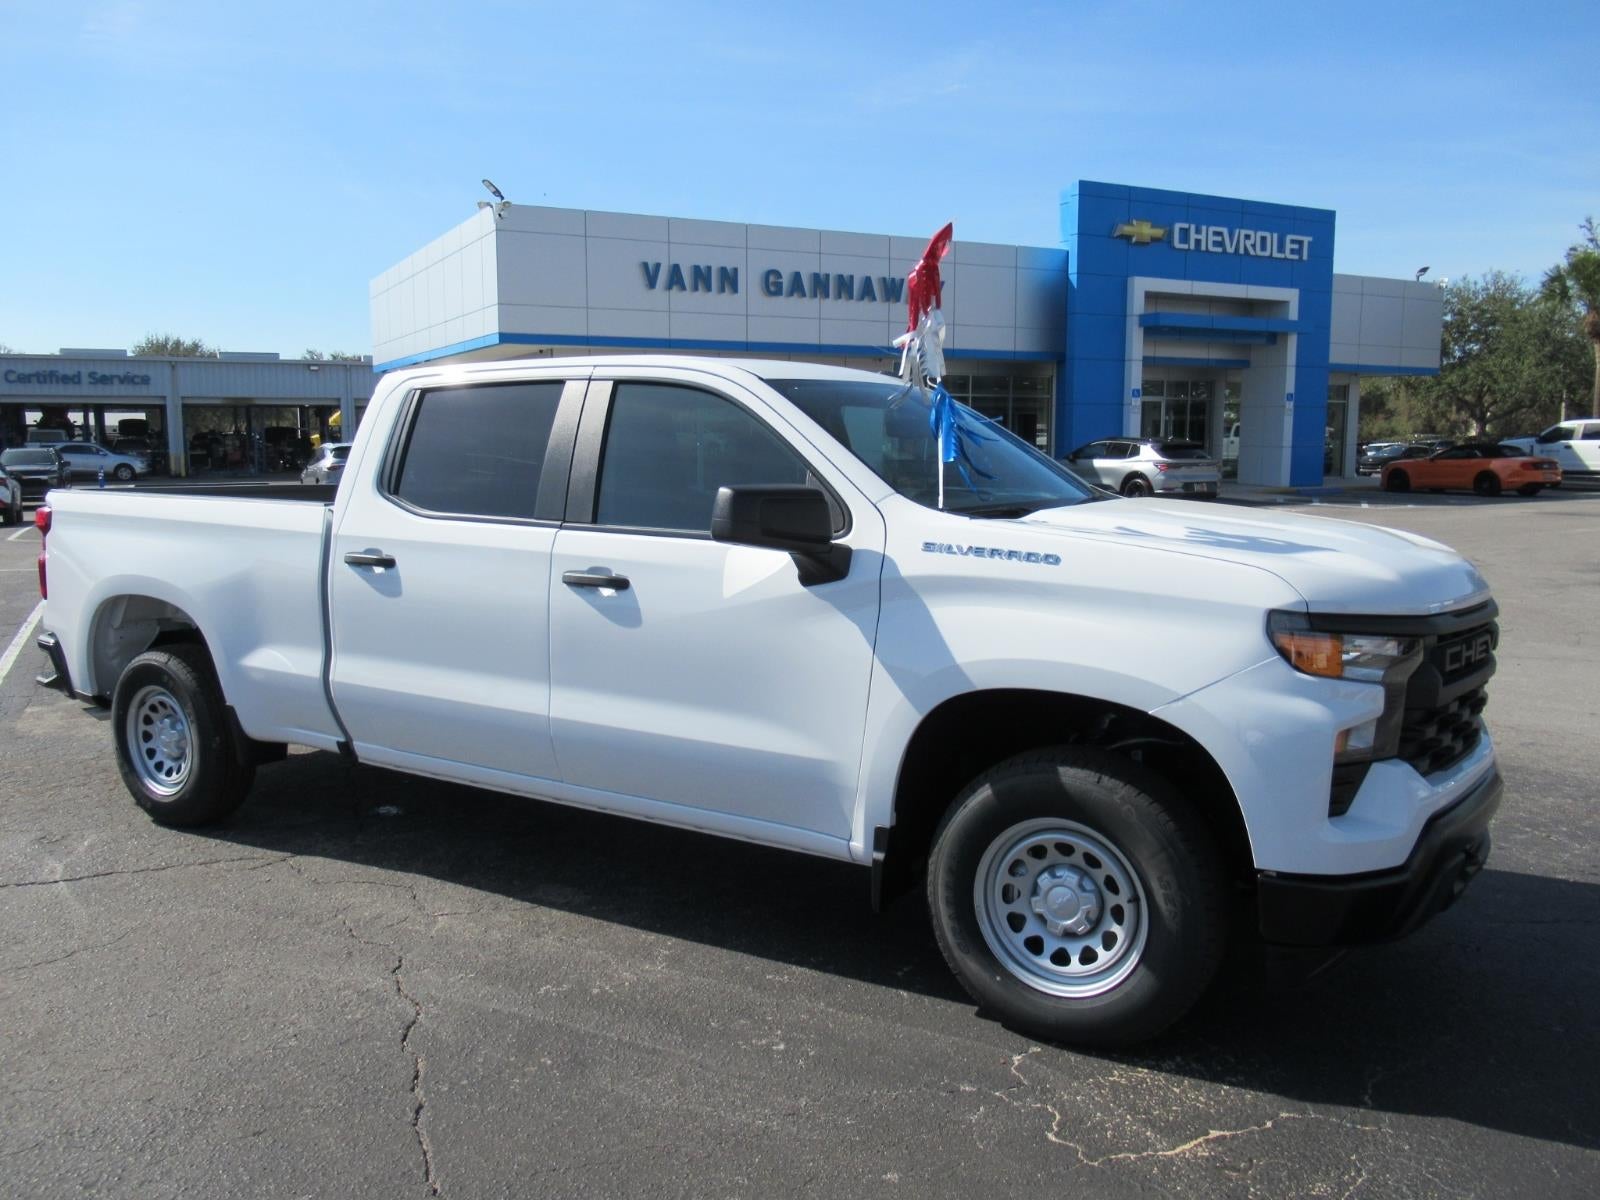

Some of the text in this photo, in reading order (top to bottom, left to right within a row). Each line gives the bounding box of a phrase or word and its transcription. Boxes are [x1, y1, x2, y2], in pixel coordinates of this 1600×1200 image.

[1173, 222, 1313, 261] CHEVROLET
[640, 260, 945, 304] VANN GANNAW
[4, 369, 151, 385] Certified Service
[921, 541, 1062, 566] SILVERADO
